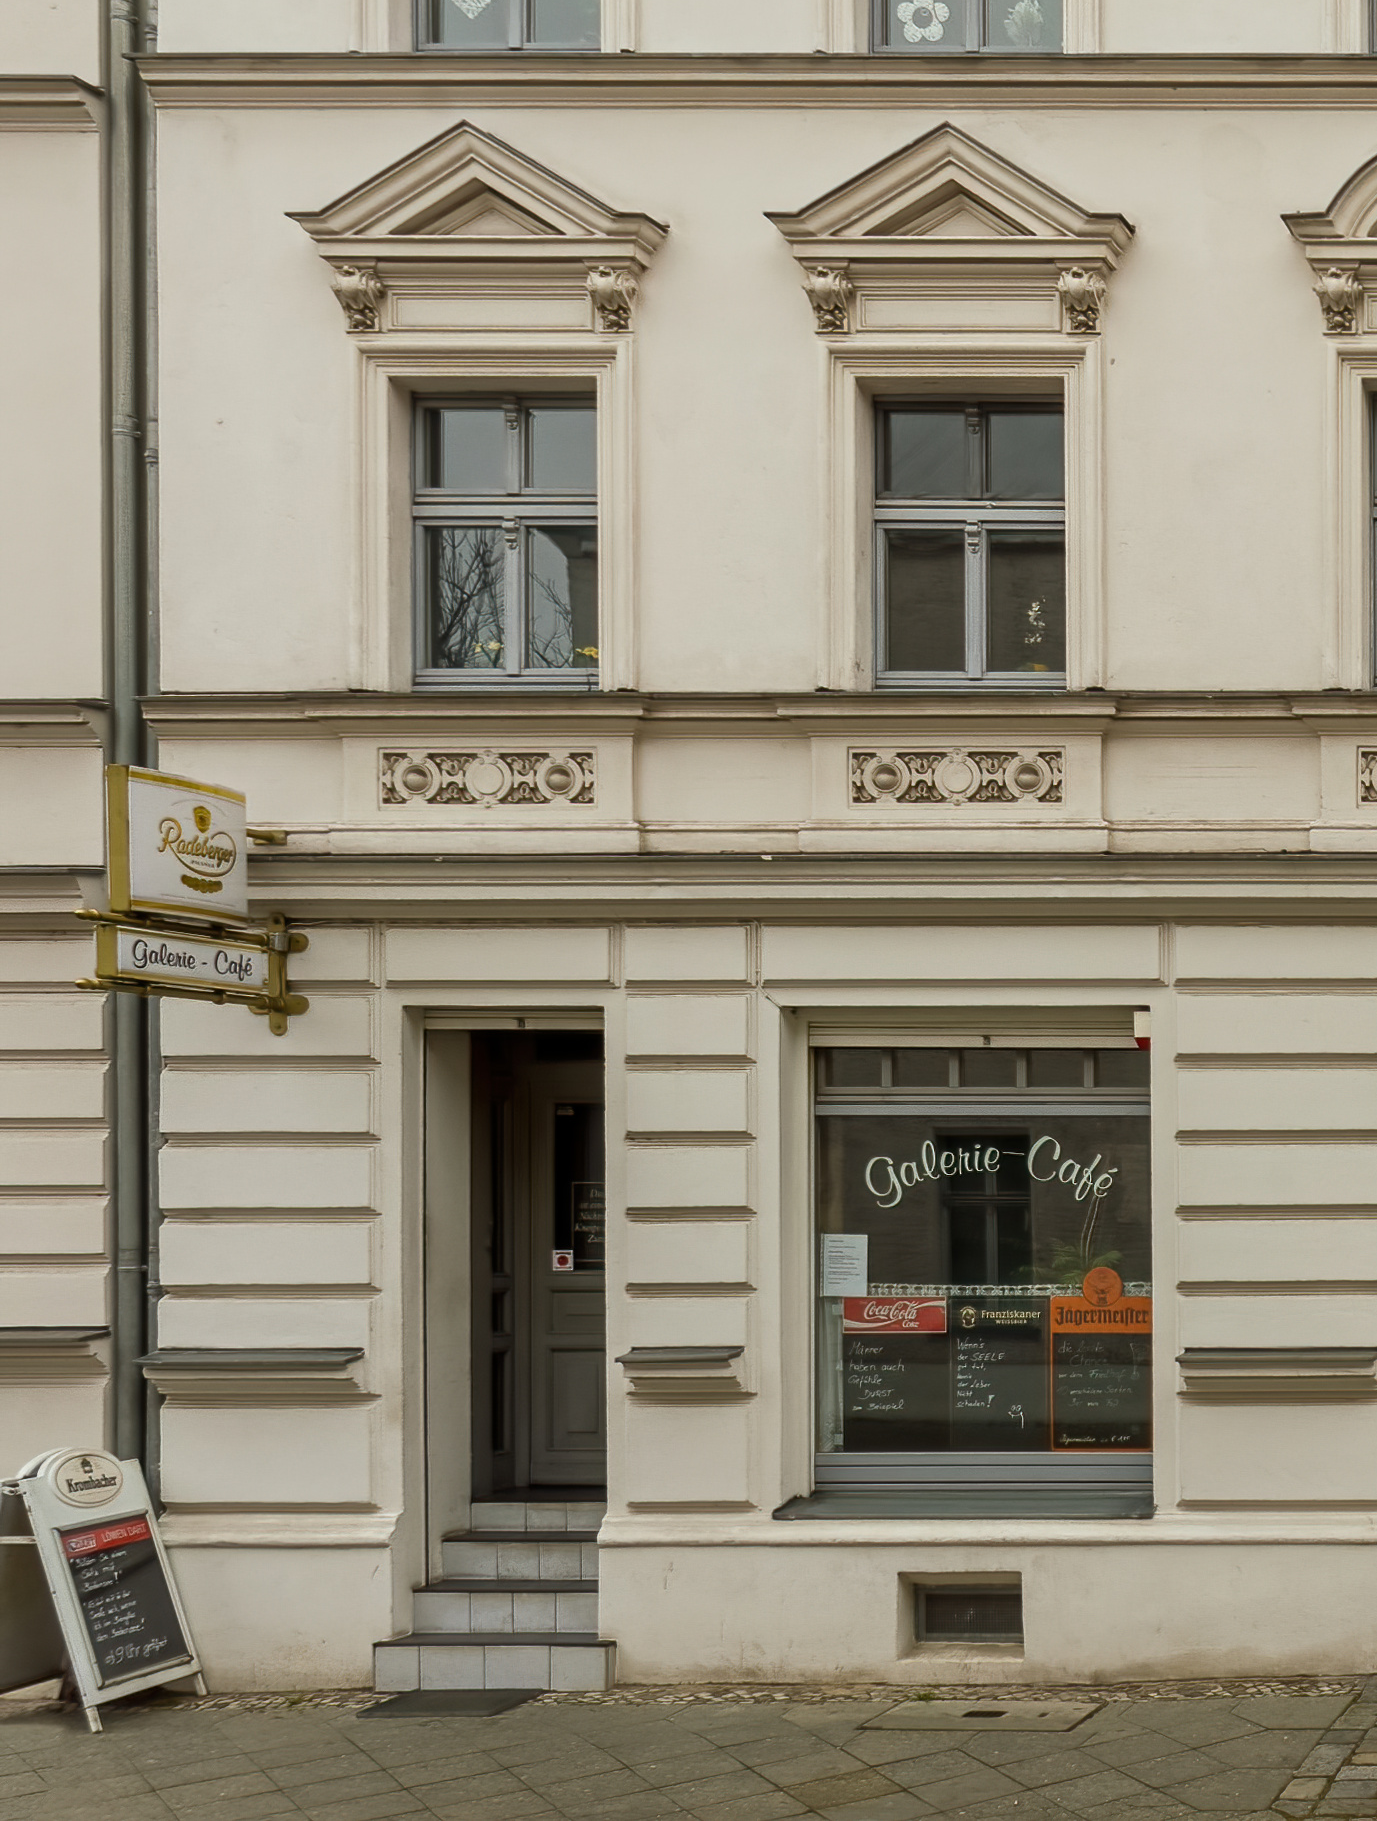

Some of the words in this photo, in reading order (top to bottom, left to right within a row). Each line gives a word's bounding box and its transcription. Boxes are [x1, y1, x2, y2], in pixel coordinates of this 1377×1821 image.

[157, 817, 236, 877] Radeberger
[132, 939, 196, 969] Galerie
[214, 949, 253, 981] Café
[865, 1140, 1000, 1208] Galerie
[1027, 1135, 1119, 1201] Café
[863, 1300, 919, 1320] Coca-Cola
[981, 1309, 1041, 1319] Franziskaner
[1055, 1306, 1149, 1326] Jägermeister
[849, 1360, 877, 1372] haben
[881, 1358, 906, 1372] auch
[971, 1352, 1006, 1361] SEELE
[65, 1473, 117, 1493] Krombacher
